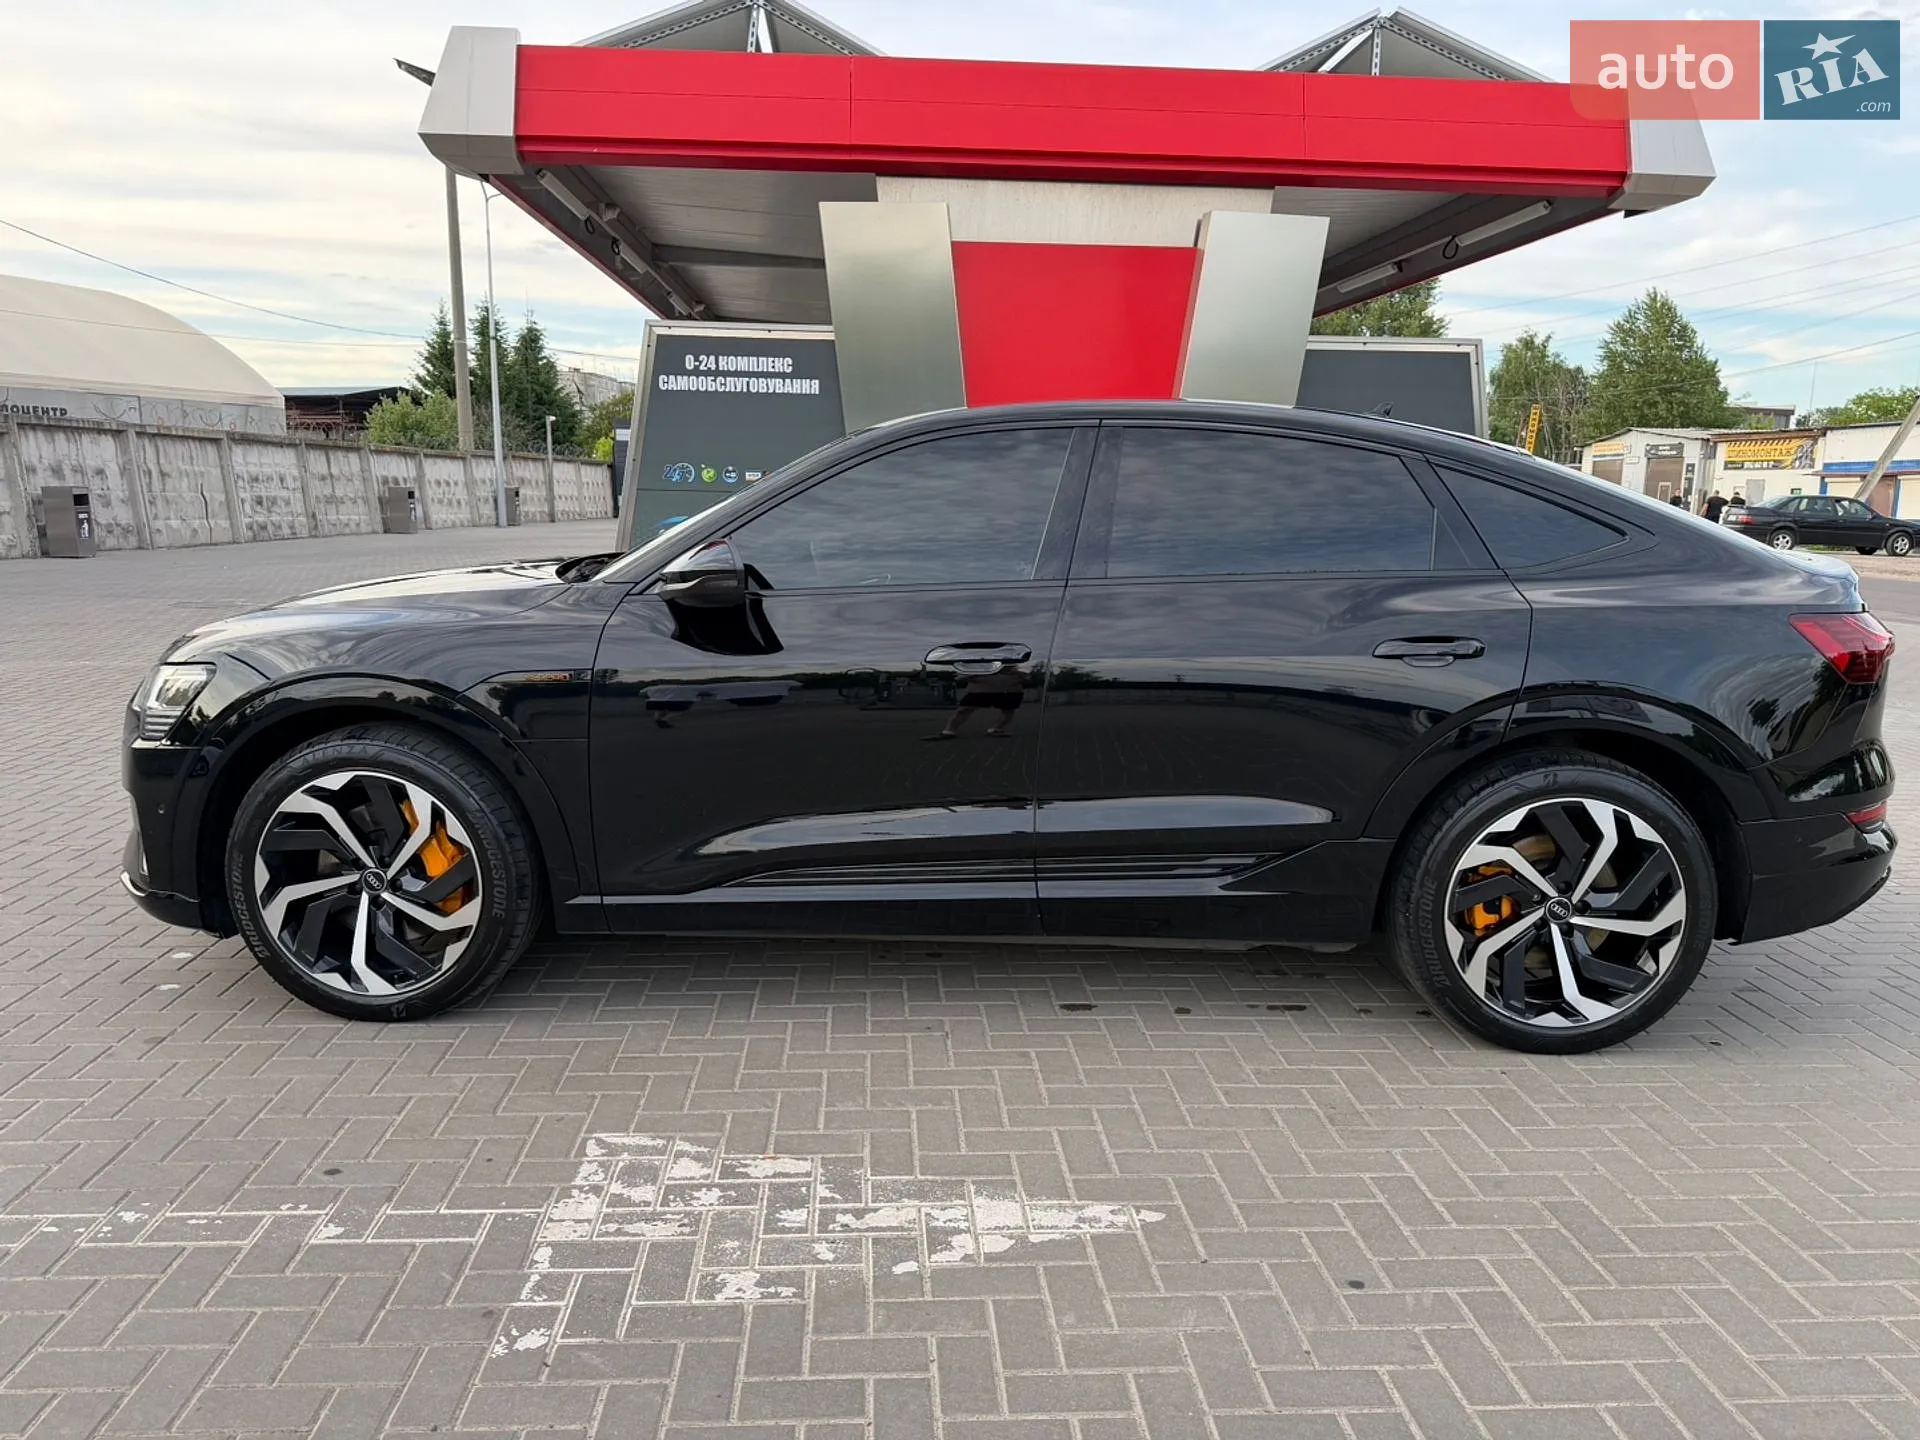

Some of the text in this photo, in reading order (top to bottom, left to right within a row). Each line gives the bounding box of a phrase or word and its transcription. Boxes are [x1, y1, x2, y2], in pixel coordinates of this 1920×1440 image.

[685, 354, 793, 373] 0-24 КОМПЛЕКС
[658, 375, 820, 395] САМООБСЛУГОВУВАННЯ
